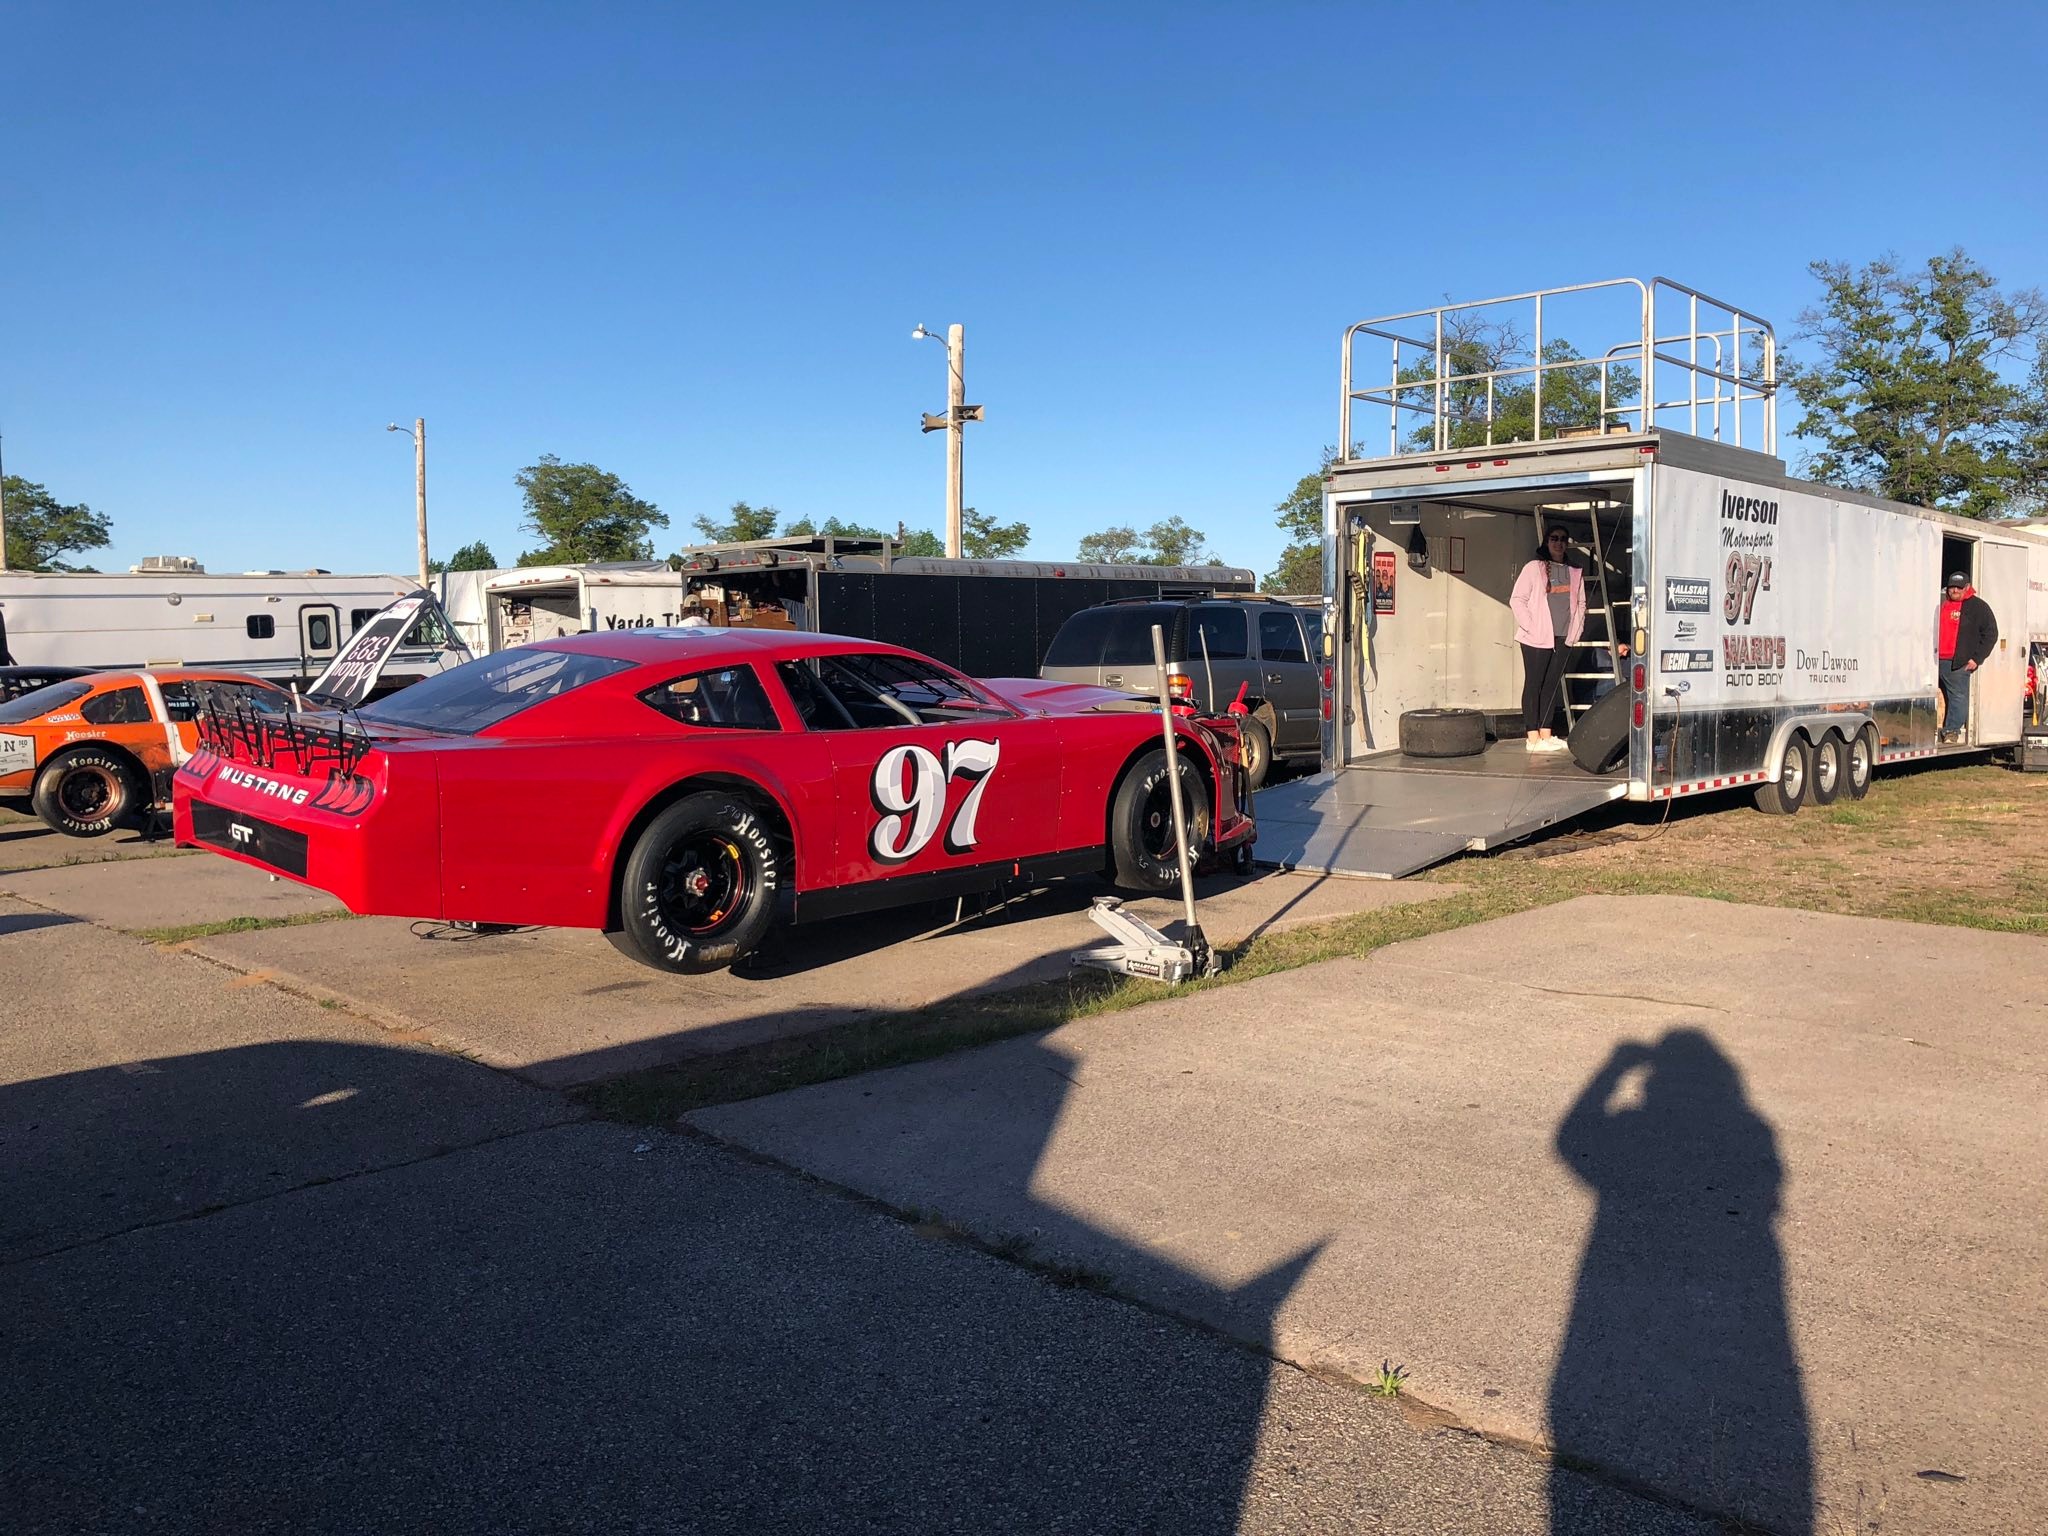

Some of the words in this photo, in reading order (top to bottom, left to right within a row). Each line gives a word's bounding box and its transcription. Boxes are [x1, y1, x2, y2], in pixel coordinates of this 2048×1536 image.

[1721, 489, 1778, 525] Iverson
[1722, 526, 1773, 552] Motorsports
[1675, 585, 1708, 595] ALLSTAR
[605, 614, 655, 630] Varda
[348, 635, 390, 660] 323
[1722, 634, 1786, 670] WARD'S
[1669, 652, 1690, 671] ECHO
[1796, 649, 1818, 670] Dow
[1822, 650, 1858, 671] Dawson
[1726, 673, 1753, 687] AUTO
[1758, 673, 1783, 685] BODY
[1809, 674, 1847, 683] TRUCKING
[64, 729, 108, 741] Hoosier
[68, 757, 121, 771] Hoosier
[219, 765, 309, 804] MUSTANG
[867, 737, 1000, 865] 97
[62, 817, 112, 831] Hoosier
[231, 823, 253, 843] GT
[732, 812, 776, 890] Hoosier
[640, 882, 692, 961] Hoosier
